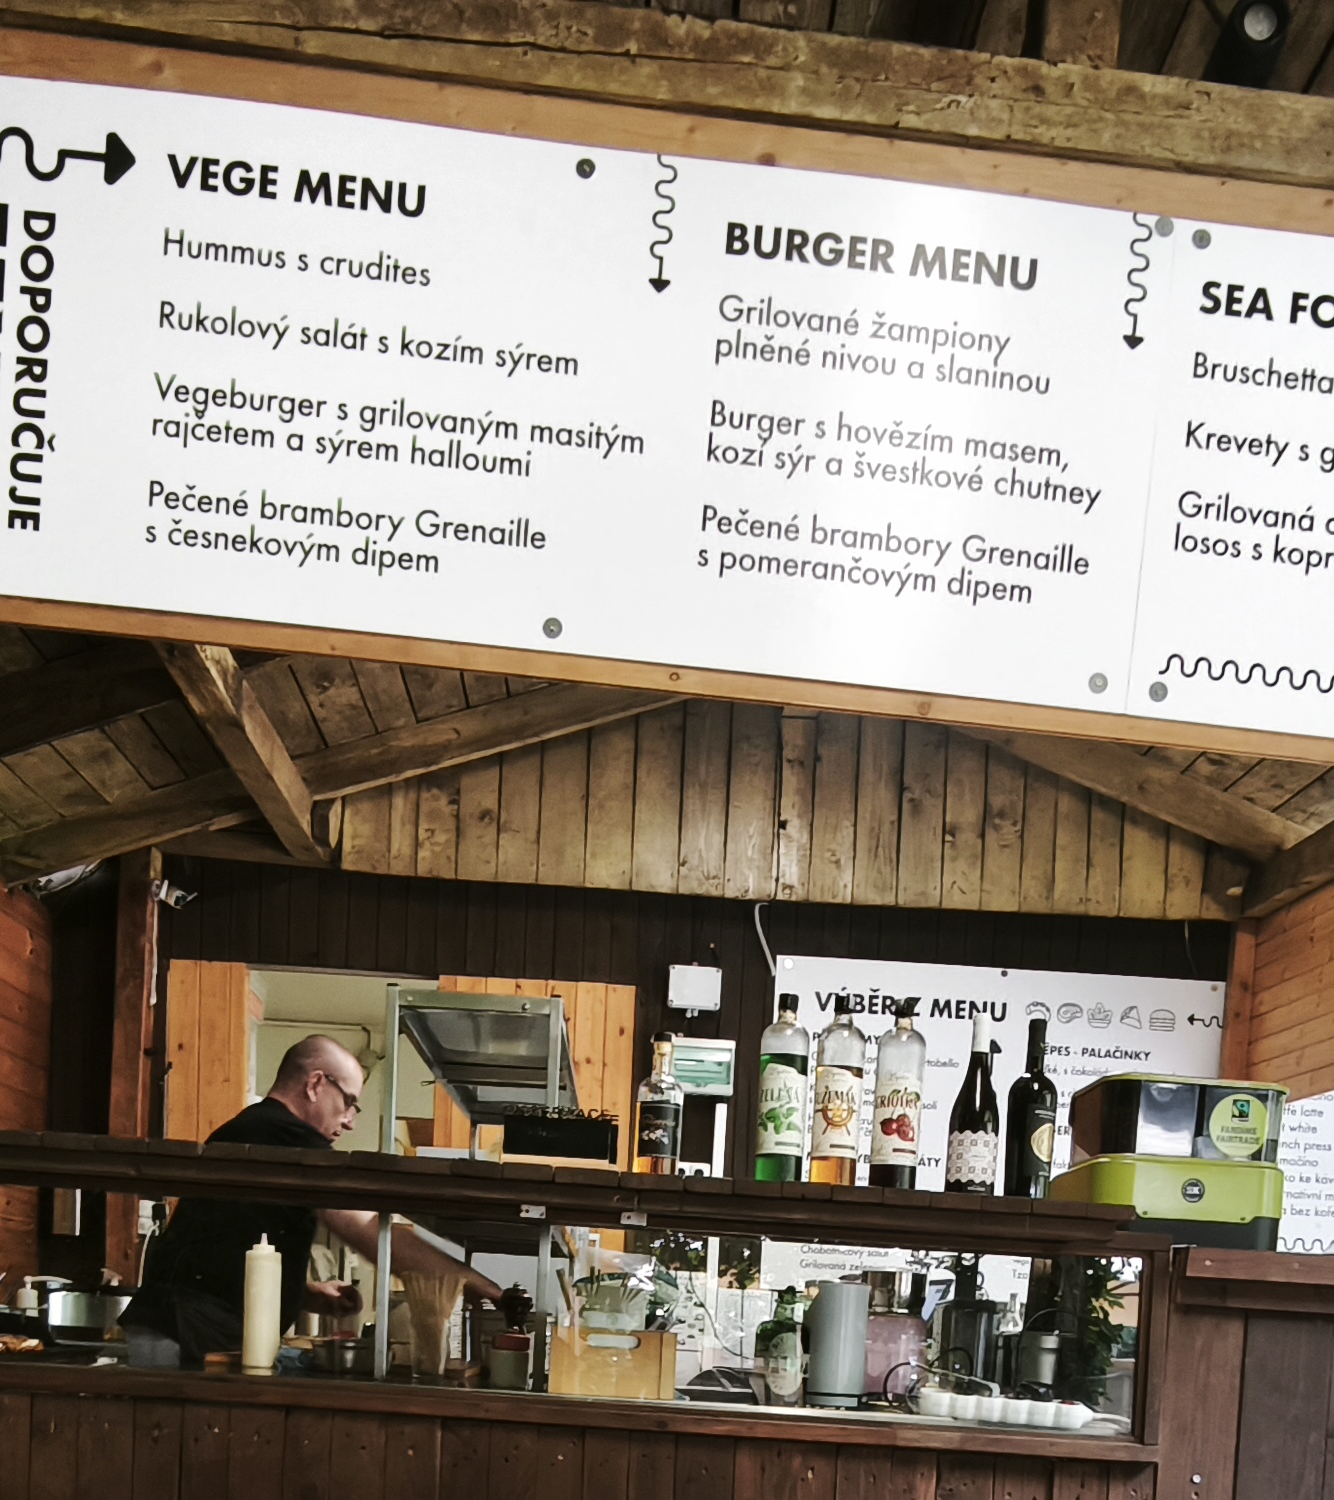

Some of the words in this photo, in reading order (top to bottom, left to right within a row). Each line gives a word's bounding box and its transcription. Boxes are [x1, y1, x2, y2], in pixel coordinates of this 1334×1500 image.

[167, 153, 279, 200] VEGE
[293, 169, 426, 218] MENU
[163, 227, 286, 269] Hummus
[298, 254, 308, 272] s
[320, 251, 430, 287] crudites
[725, 222, 894, 273] BURGER
[909, 244, 1038, 291] MENU
[719, 294, 859, 335] Grilované
[870, 312, 1010, 367] žampiony
[1199, 281, 1274, 322] SEA
[8, 210, 56, 532] DOPORUČUJE
[159, 300, 290, 350] Rukolový
[300, 318, 368, 351] salát
[378, 336, 389, 354] s
[400, 326, 483, 365] kozím
[495, 343, 578, 377] sýrem
[715, 329, 810, 366] plněné
[822, 343, 895, 375] nivou
[908, 361, 924, 378] a
[936, 353, 1050, 394] slaninou
[1193, 351, 1334, 394] Bruschetta
[152, 412, 274, 448] rajčetem
[286, 433, 303, 451] a
[316, 429, 398, 464] sýrem
[411, 435, 531, 477] halloumi
[154, 372, 327, 423] Vegeburger
[337, 403, 348, 421] s
[359, 398, 518, 445] grilovaným
[530, 422, 644, 459] masitým
[711, 400, 805, 448] Burger
[815, 421, 826, 439] s
[837, 411, 952, 453] hovězím
[965, 439, 1068, 473] masem,
[1185, 420, 1290, 467] Krevety
[1298, 444, 1309, 462] s
[707, 431, 763, 467] kozí
[775, 444, 816, 479] sýr
[826, 458, 842, 476] a
[854, 451, 983, 492] švestkové
[994, 467, 1102, 515] chutney
[149, 480, 248, 517] Pečené
[260, 489, 405, 542] brambory
[415, 510, 546, 549] Grenaille
[701, 504, 799, 541] Pečené
[811, 514, 952, 566] brambory
[962, 535, 1089, 575] Grenaille
[1174, 522, 1241, 558] losos
[1252, 543, 1262, 561] s
[1178, 491, 1314, 532] Grilovaná
[145, 526, 156, 543] s
[168, 518, 339, 568] česnekovým
[352, 536, 438, 576] dipem
[697, 549, 708, 567] s
[719, 551, 935, 597] pomerančovým
[947, 566, 1032, 606] dipem
[929, 999, 1008, 1022] MENU
[1081, 1045, 1152, 1061] PALAČINKY
